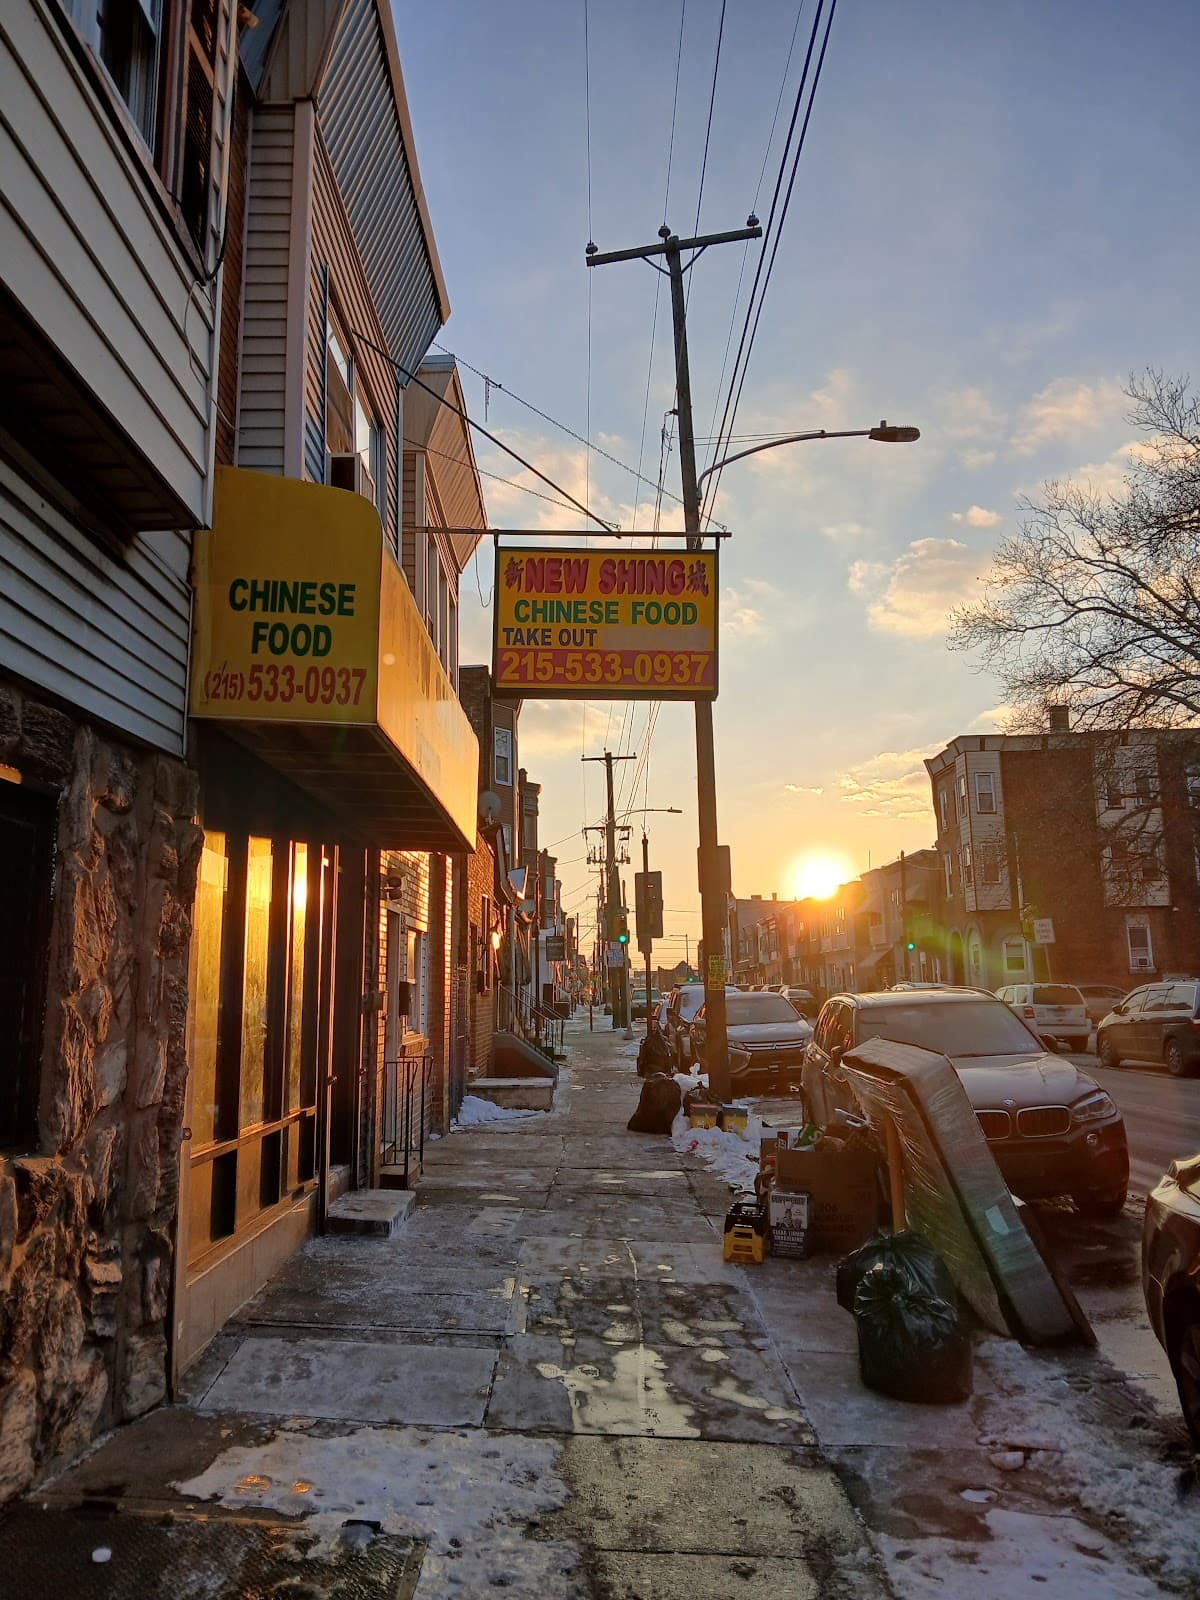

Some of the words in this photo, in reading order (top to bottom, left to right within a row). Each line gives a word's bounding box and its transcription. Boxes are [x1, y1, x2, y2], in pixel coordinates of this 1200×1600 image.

[525, 557, 589, 594] NEW
[598, 558, 686, 596] SHING
[228, 578, 356, 617] CHINESE
[514, 599, 619, 624] CHINESE
[631, 601, 698, 625] FOOD
[251, 621, 333, 657] FOOD
[502, 627, 552, 646] TAKE
[558, 628, 598, 647] OUT
[501, 651, 709, 683] 215-533-0937
